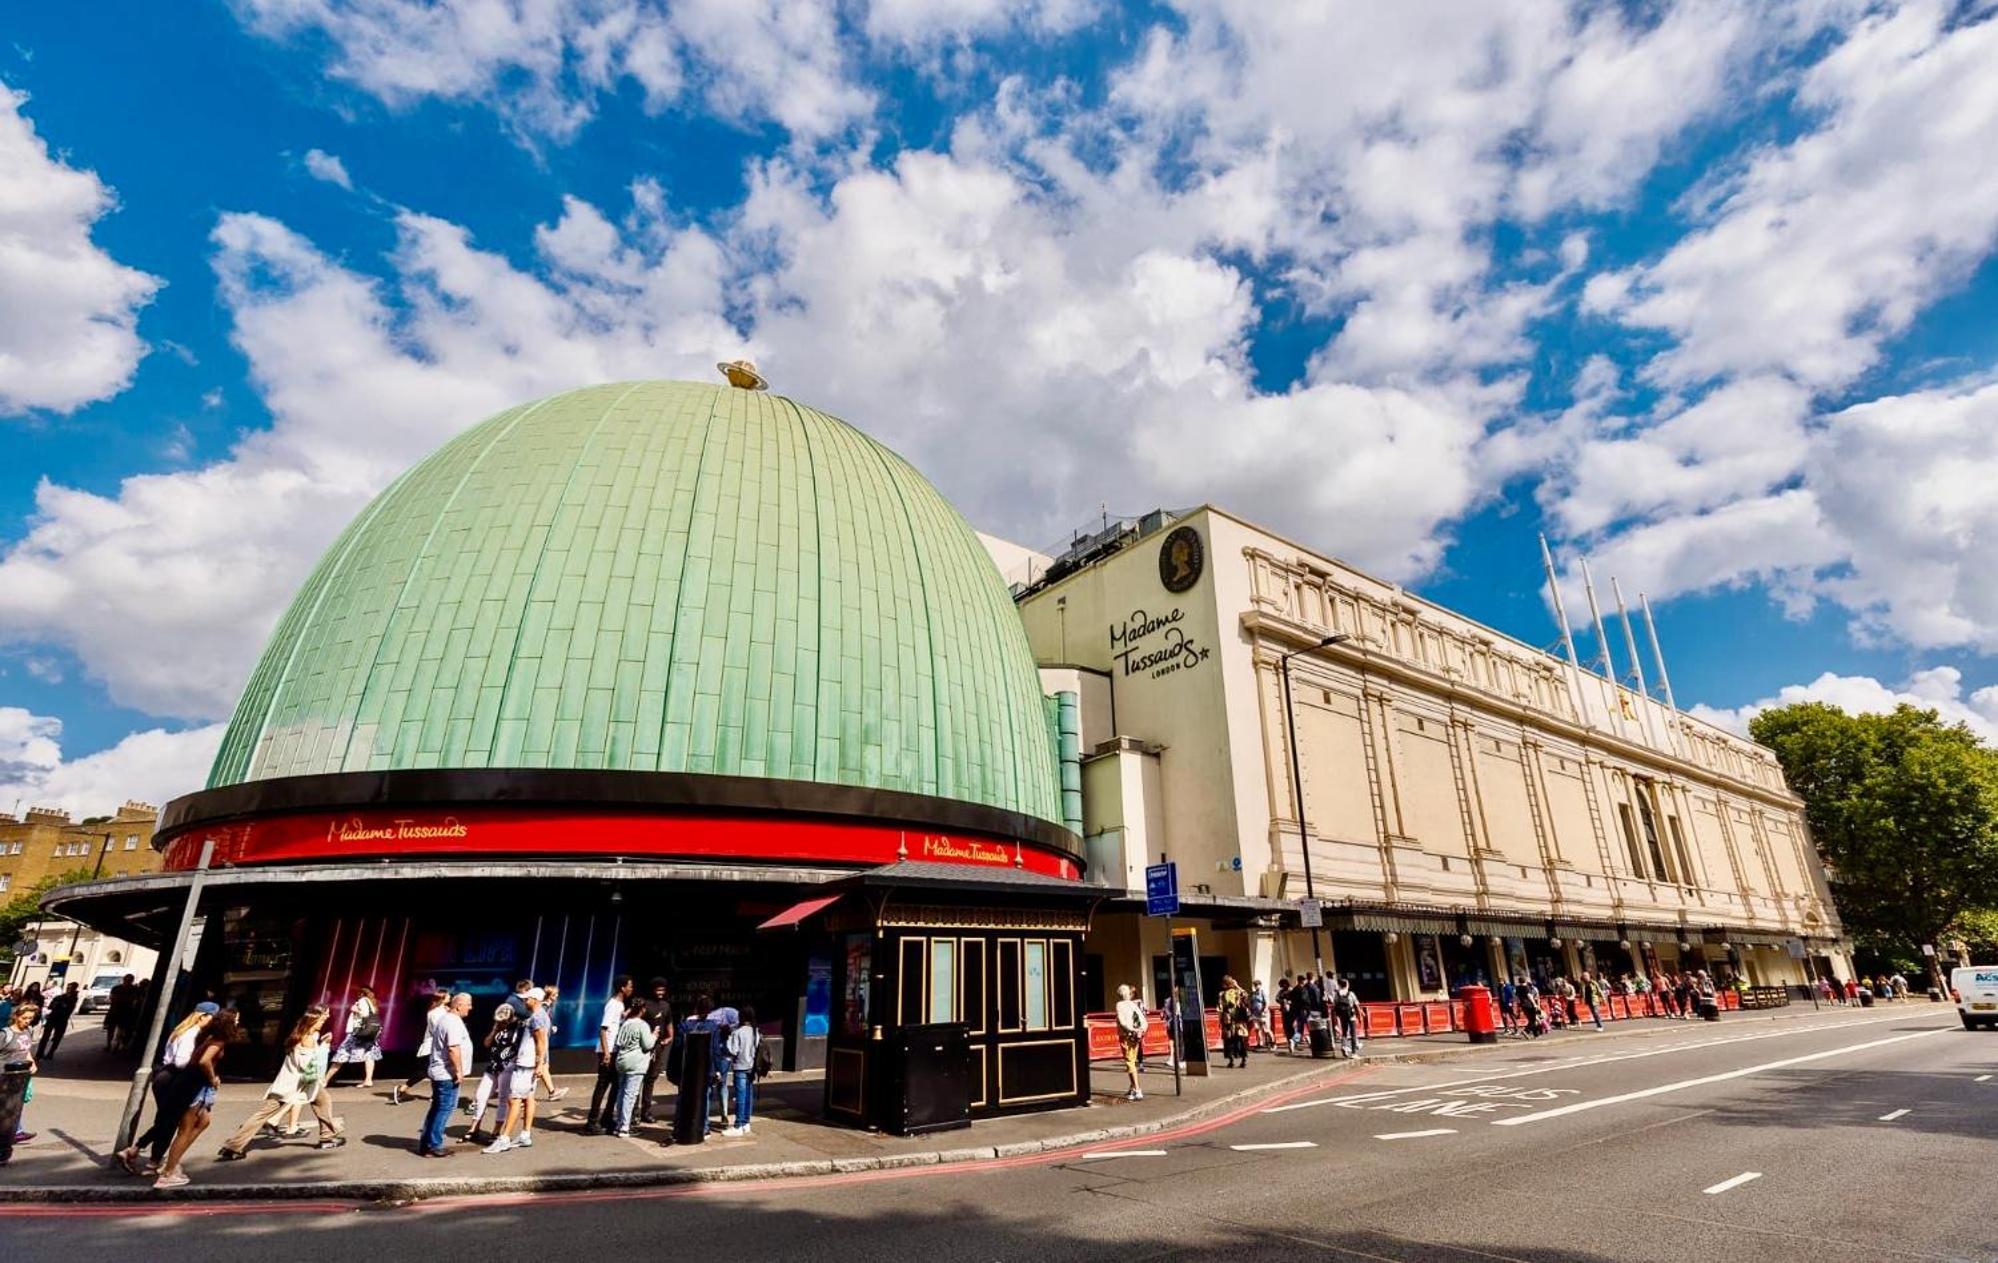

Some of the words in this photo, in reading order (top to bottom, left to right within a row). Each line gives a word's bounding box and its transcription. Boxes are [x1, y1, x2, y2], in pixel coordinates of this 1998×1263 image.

[1109, 608, 1185, 650] Madame
[1113, 627, 1199, 676] Tussauds
[1151, 663, 1181, 679] LONDON
[327, 818, 395, 842] Madame
[395, 816, 467, 839] Tussauds
[923, 835, 971, 857] Madame
[969, 842, 1008, 863] Tussauds
[1437, 1086, 1581, 1100] BUS
[1334, 1095, 1533, 1118] LANE
